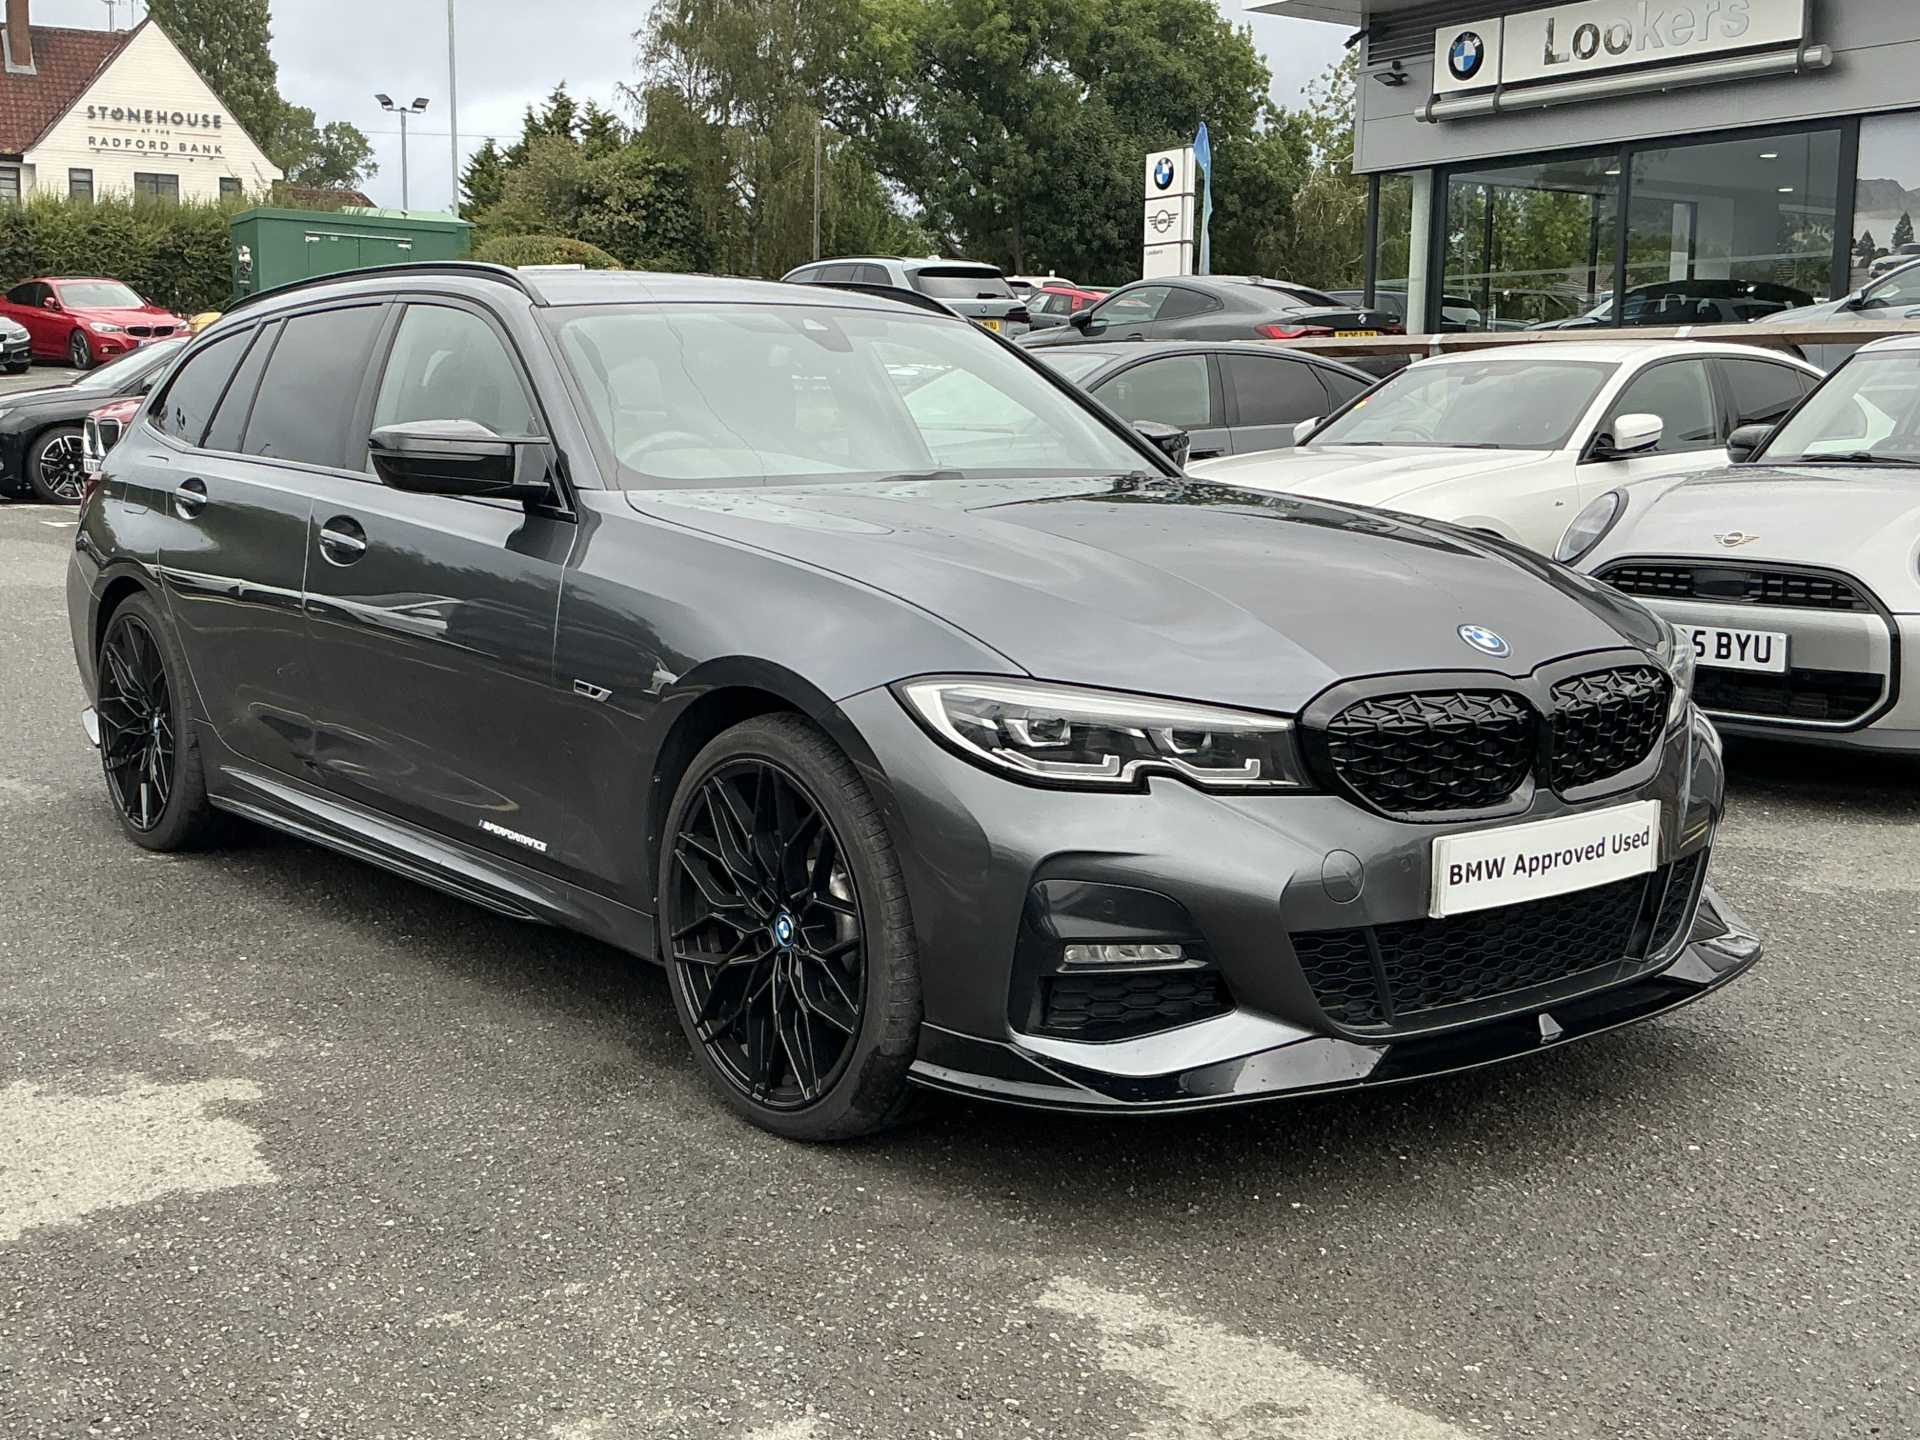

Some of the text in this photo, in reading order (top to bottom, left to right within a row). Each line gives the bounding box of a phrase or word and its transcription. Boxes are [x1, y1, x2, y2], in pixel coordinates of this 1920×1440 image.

[1543, 0, 1751, 66] Lookers
[87, 105, 222, 129] STONEHOUSE
[88, 136, 222, 154] RADFORD BANK
[1714, 631, 1772, 664] BYU
[1449, 825, 1650, 886] BMW Approved Used
